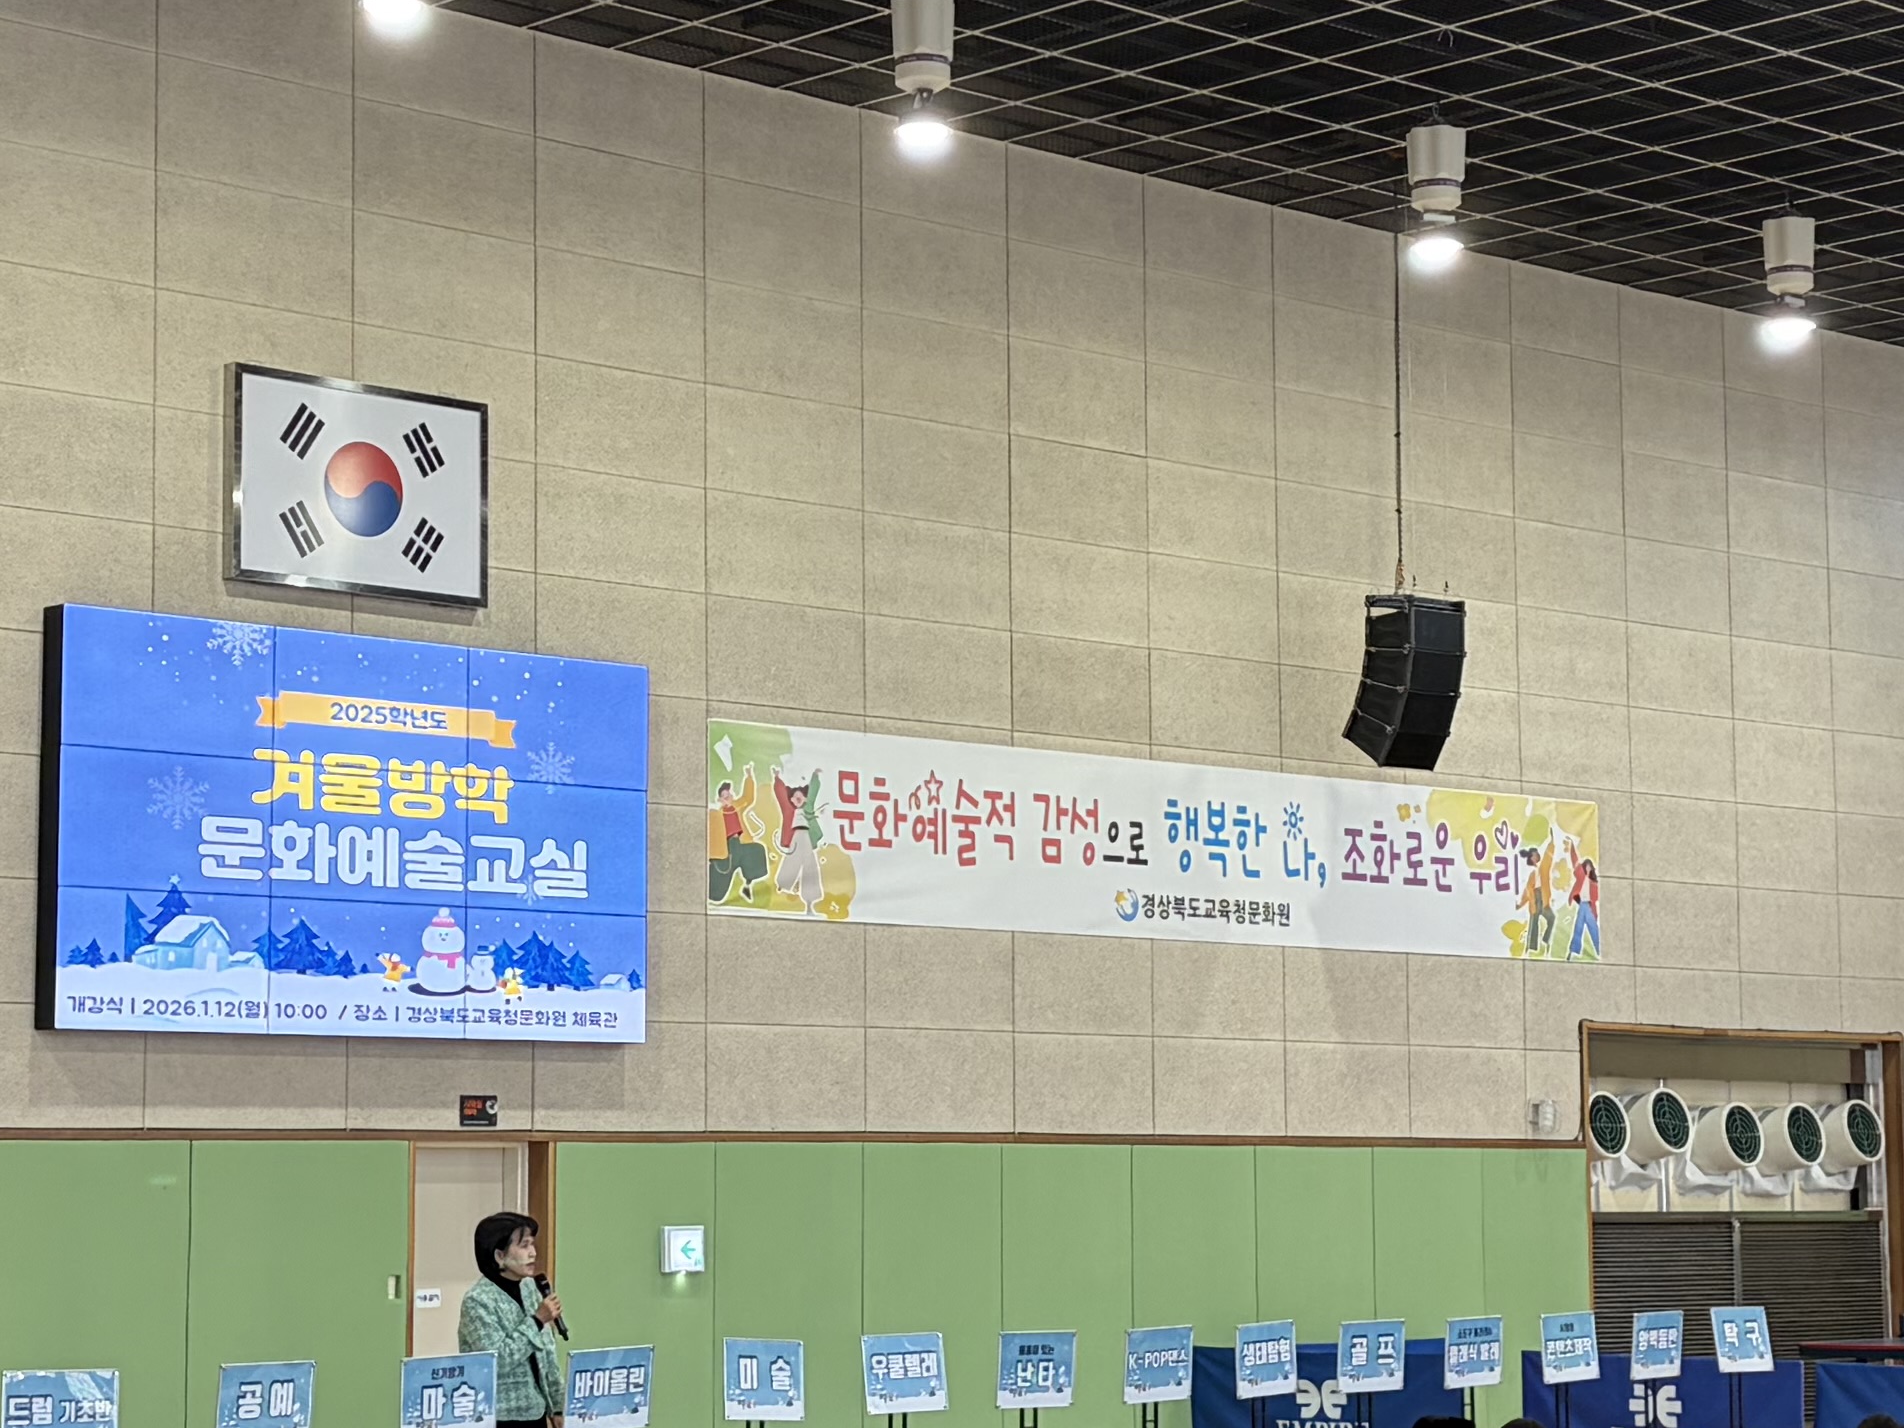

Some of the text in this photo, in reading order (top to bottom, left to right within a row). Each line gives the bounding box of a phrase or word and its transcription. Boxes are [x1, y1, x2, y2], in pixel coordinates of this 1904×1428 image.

[329, 701, 448, 730] 2025학년도
[251, 748, 515, 824] 겨울방학
[833, 769, 1015, 867] 문화예술적
[1033, 793, 1148, 866] 감성으로
[1164, 798, 1267, 879] 행복한
[1341, 820, 1455, 893] 조화로운
[1469, 822, 1520, 895] 우리
[198, 814, 589, 899] 문화예술교실
[1141, 893, 1291, 927] 경상북도교육청문화원
[67, 996, 123, 1014] 개강식
[142, 999, 268, 1019] 2026.1.12(월)
[274, 1003, 327, 1020] 10:00
[353, 1004, 388, 1022] 장소
[406, 1006, 567, 1027] 경상북도교육청문화원
[573, 1012, 618, 1028] 체육관
[870, 1350, 939, 1380] 우쿨렐레
[1129, 1349, 1189, 1370] K-POP댄스
[1242, 1337, 1291, 1367] 생태탐험
[573, 1364, 646, 1399] 바이올린
[6, 1394, 113, 1426] 드럼 기초반
